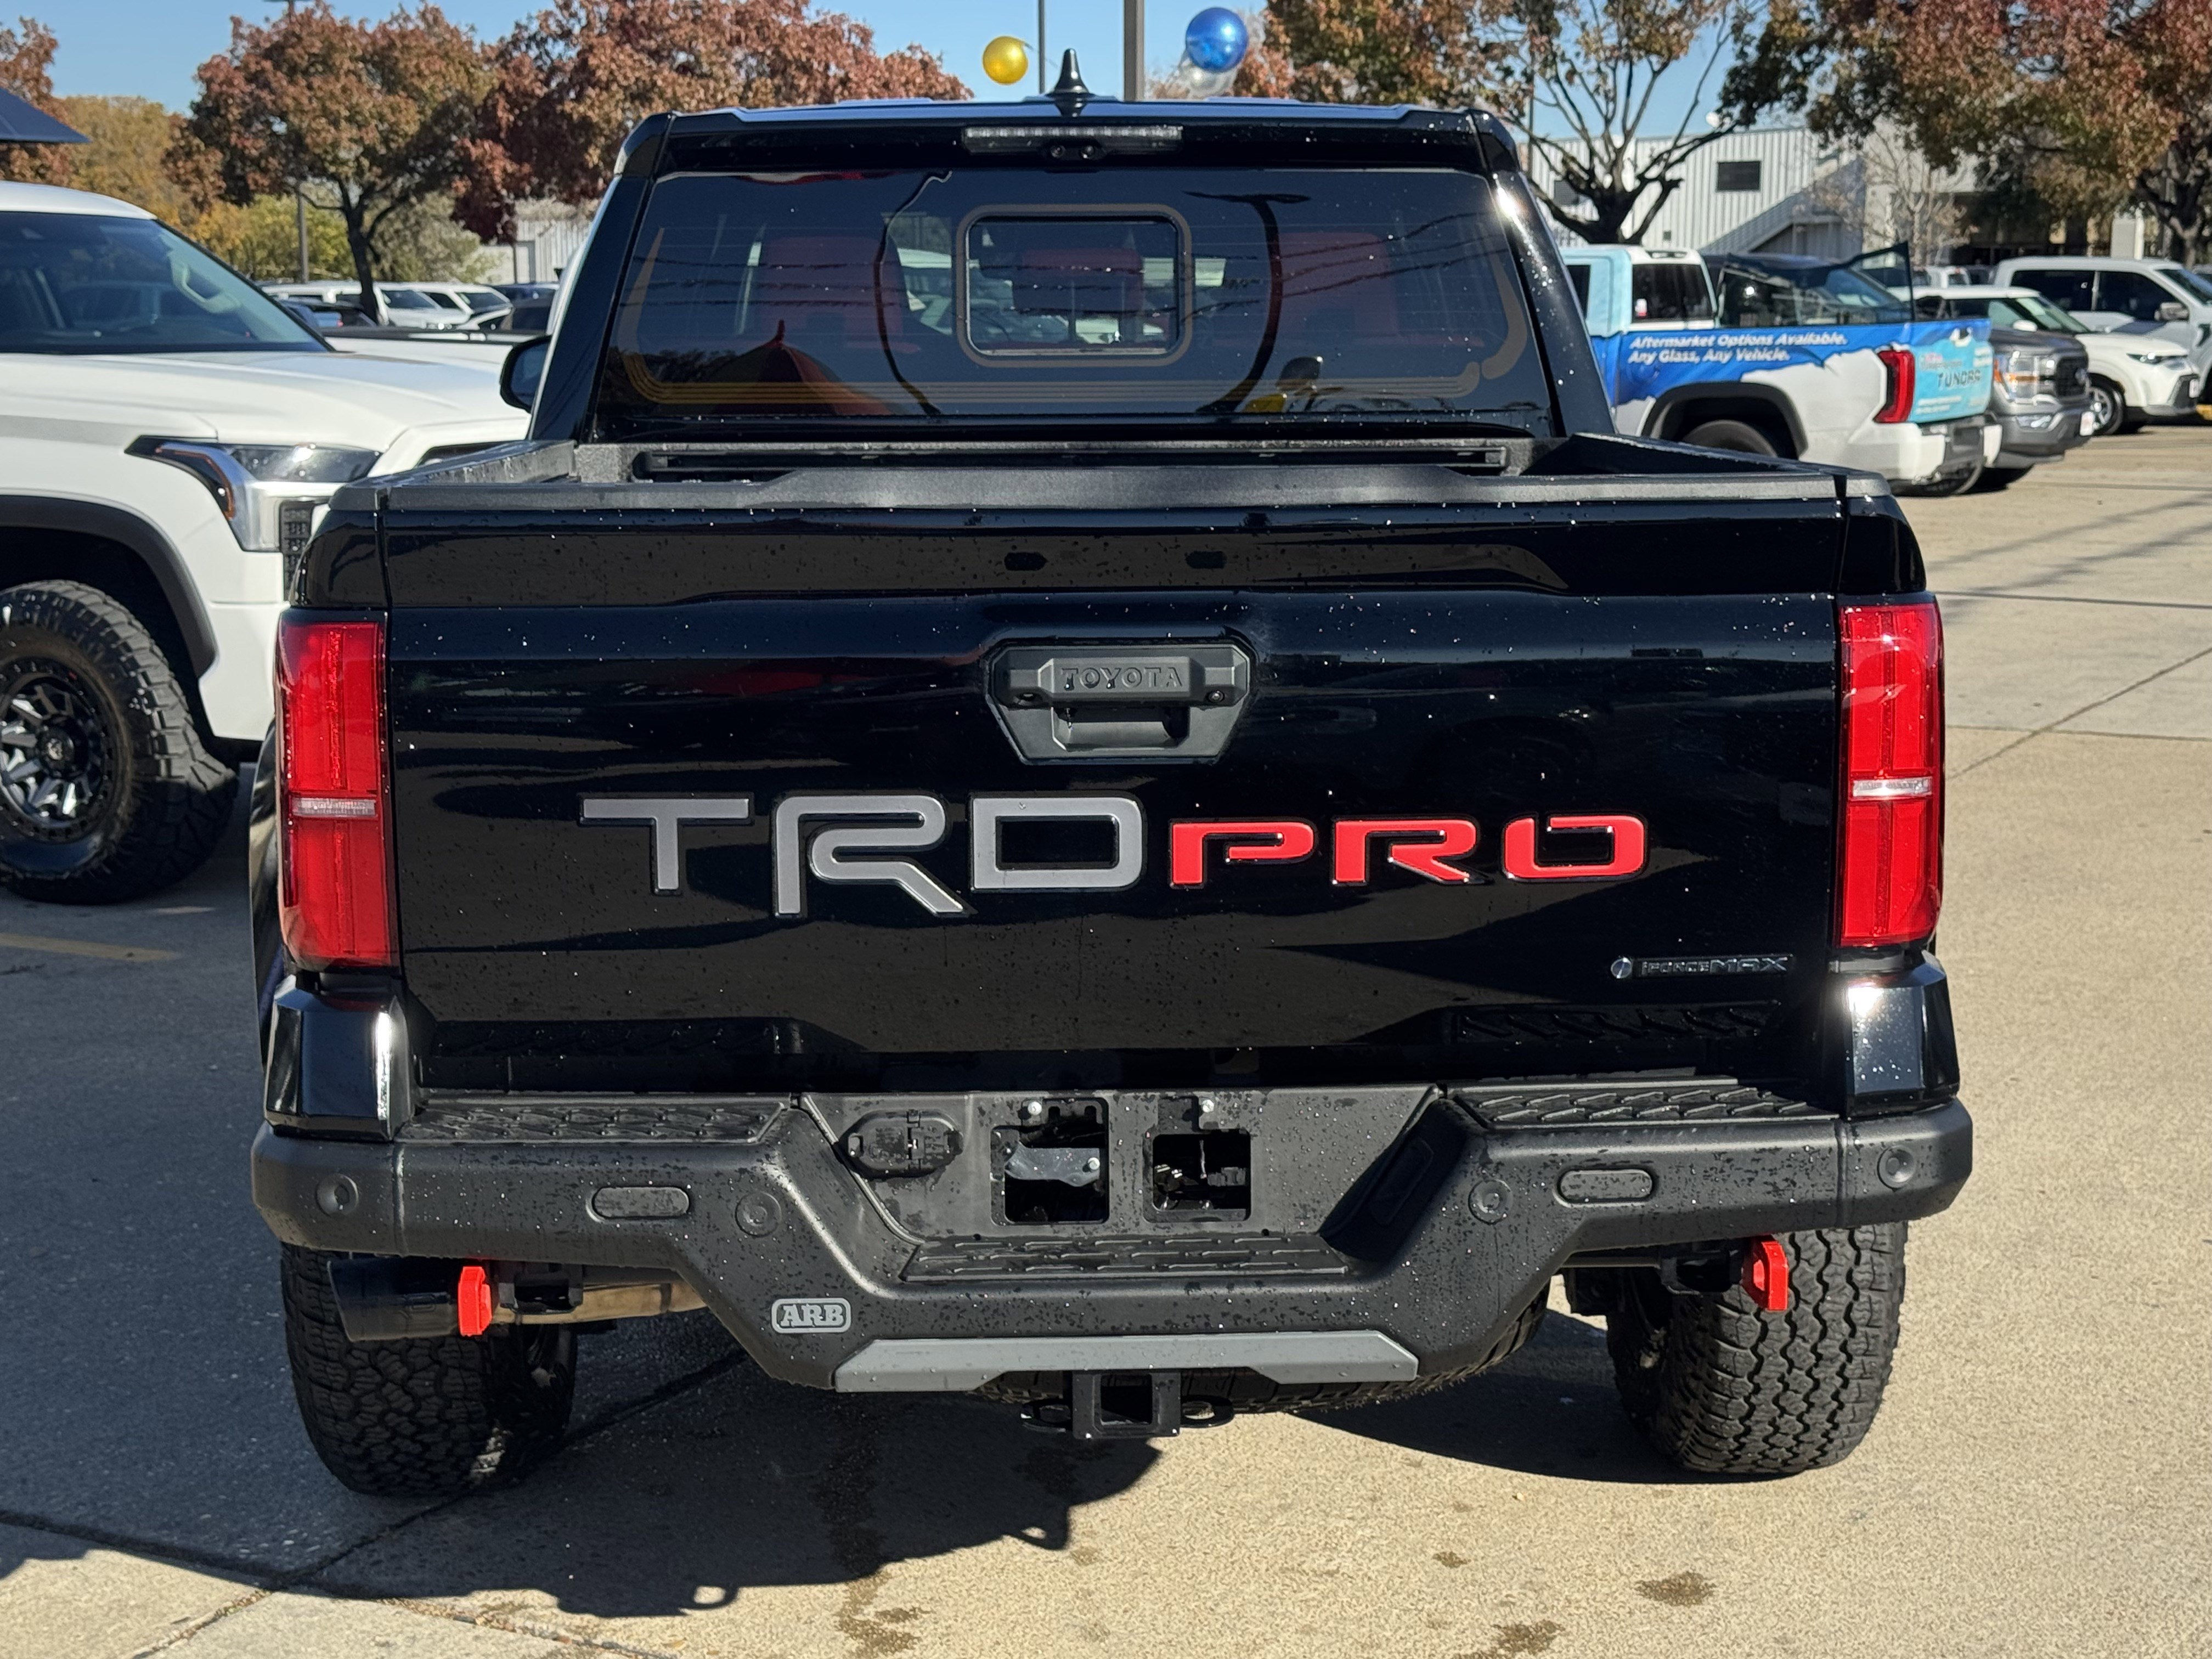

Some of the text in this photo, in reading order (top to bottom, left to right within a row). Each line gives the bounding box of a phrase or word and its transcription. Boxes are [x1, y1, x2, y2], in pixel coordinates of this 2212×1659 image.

[1630, 331, 1848, 349] Aftermarket Options Available.
[1628, 347, 1791, 365] Any Glass, Any Vehicle.
[1061, 667, 1183, 690] TOYOTA
[582, 794, 1645, 916] TRD PRO
[780, 1304, 844, 1328] ARB
